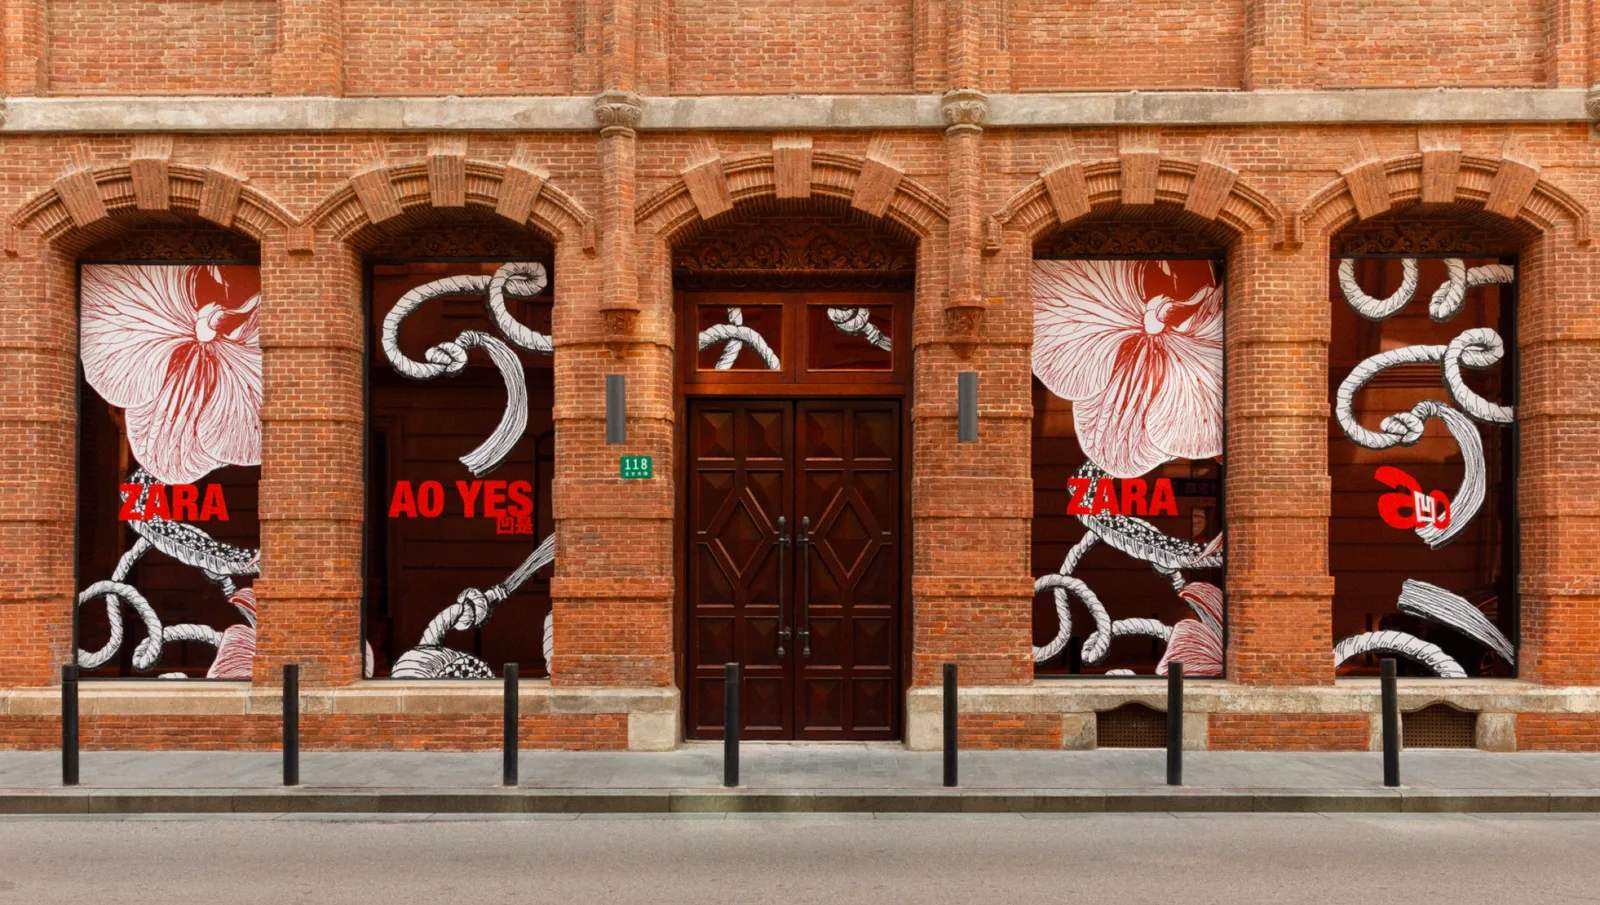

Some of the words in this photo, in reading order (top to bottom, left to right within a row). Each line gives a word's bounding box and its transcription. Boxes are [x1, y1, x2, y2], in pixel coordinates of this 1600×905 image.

[625, 458, 648, 470] 118
[119, 483, 228, 521] ZARA
[388, 480, 445, 518] AO
[456, 480, 534, 518] YES
[1066, 477, 1179, 516] ZARA
[496, 516, 534, 534] 凹是
